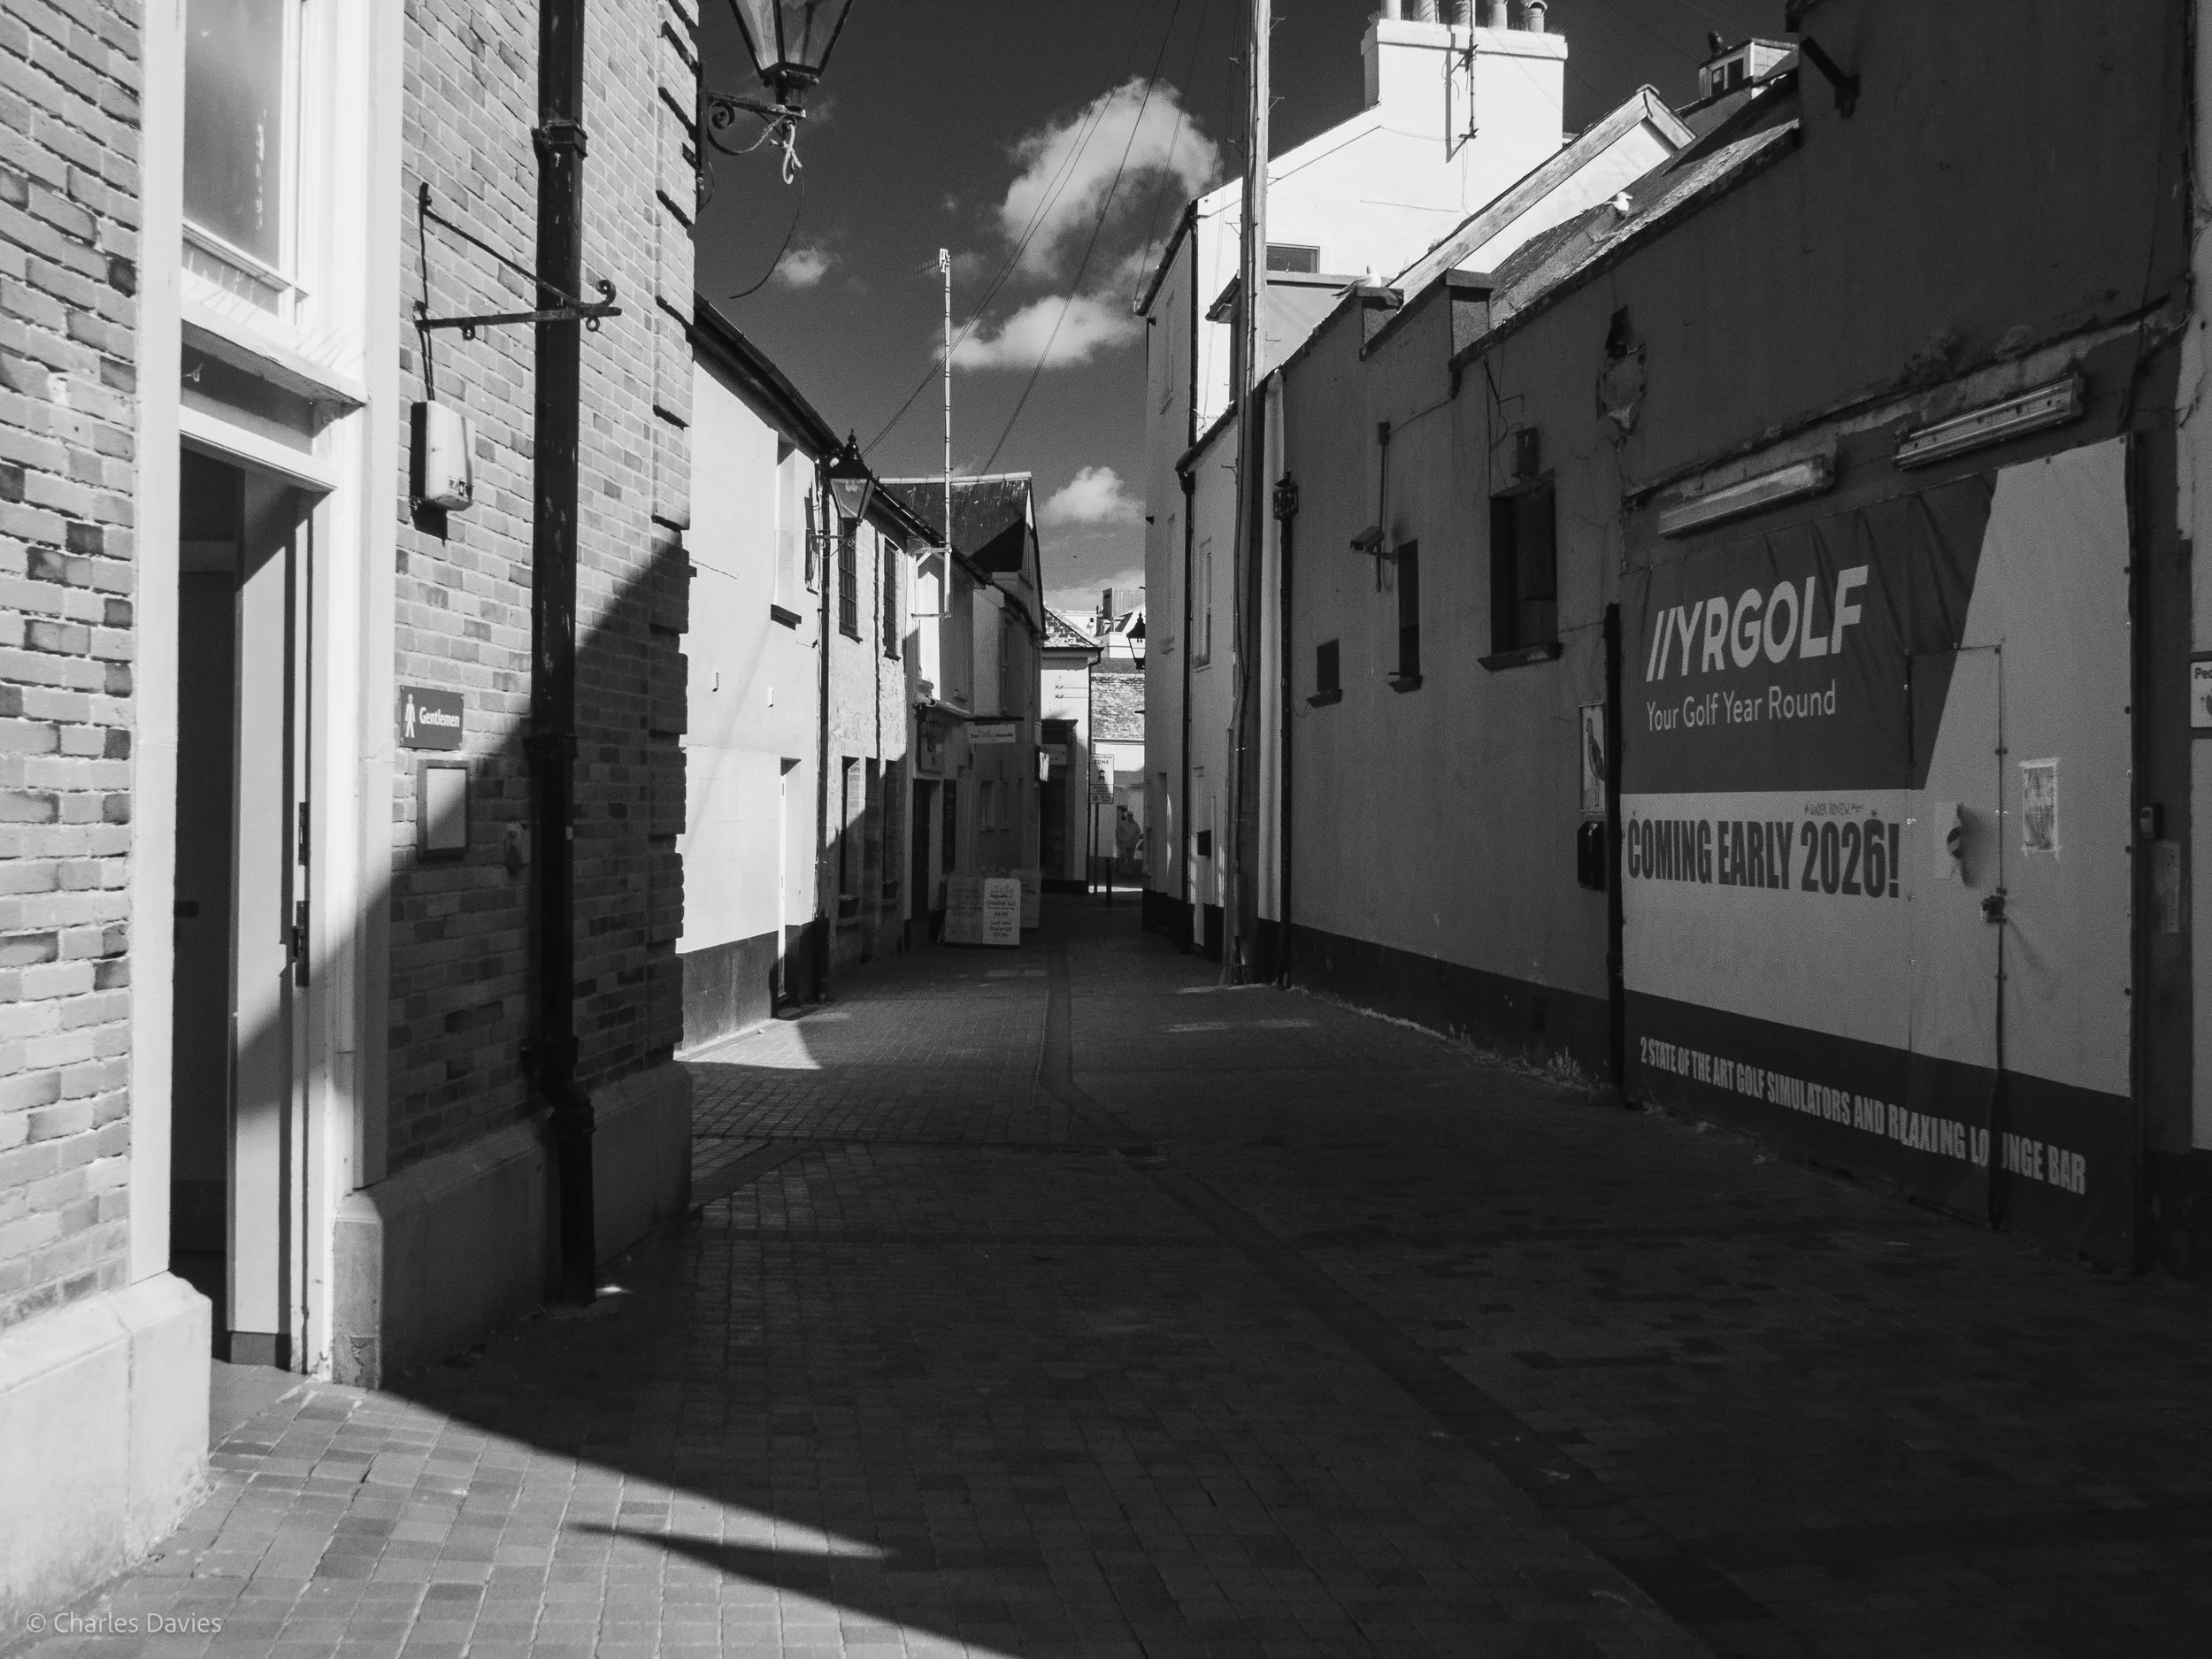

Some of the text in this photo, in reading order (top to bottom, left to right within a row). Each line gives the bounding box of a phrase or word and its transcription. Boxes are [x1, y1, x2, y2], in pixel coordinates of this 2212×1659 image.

[419, 706, 460, 727] Gentlemen
[1646, 679, 1836, 732] Your Golf Year Round
[1627, 818, 1901, 899] COMING EARLY 2026!
[1640, 1035, 1647, 1064] 2
[1647, 1038, 1678, 1073] STATE
[1677, 1046, 1691, 1076] OF
[1691, 1049, 1712, 1084] THE
[1712, 1056, 1735, 1090] ART
[1736, 1063, 1765, 1100] GOLF
[1766, 1071, 1851, 1125] SIMULATORS
[1853, 1094, 1885, 1136] AND
[2047, 1145, 2086, 1195] BAR
